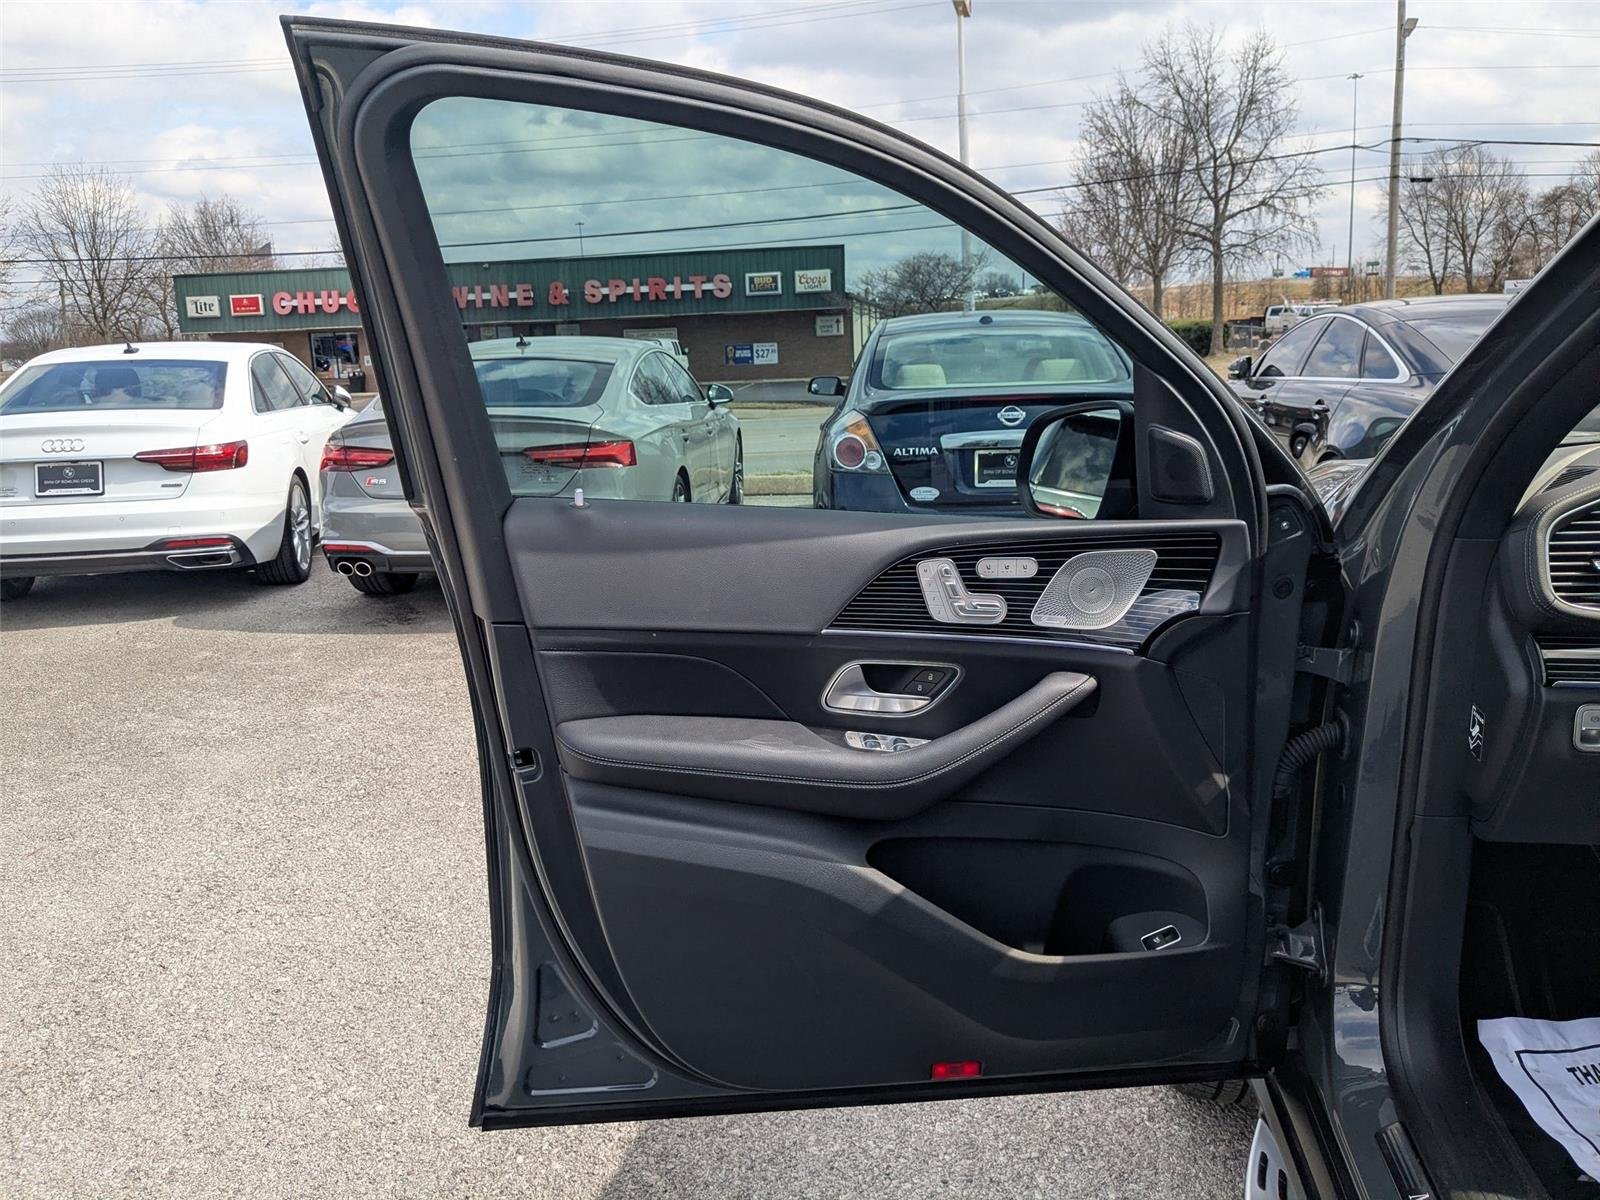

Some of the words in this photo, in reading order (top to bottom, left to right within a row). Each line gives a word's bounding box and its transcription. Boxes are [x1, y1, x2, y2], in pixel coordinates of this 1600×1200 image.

[548, 281, 569, 305] &
[584, 273, 732, 304] SPIRITS
[191, 299, 215, 315] Lite
[893, 446, 939, 456] ALTIMA
